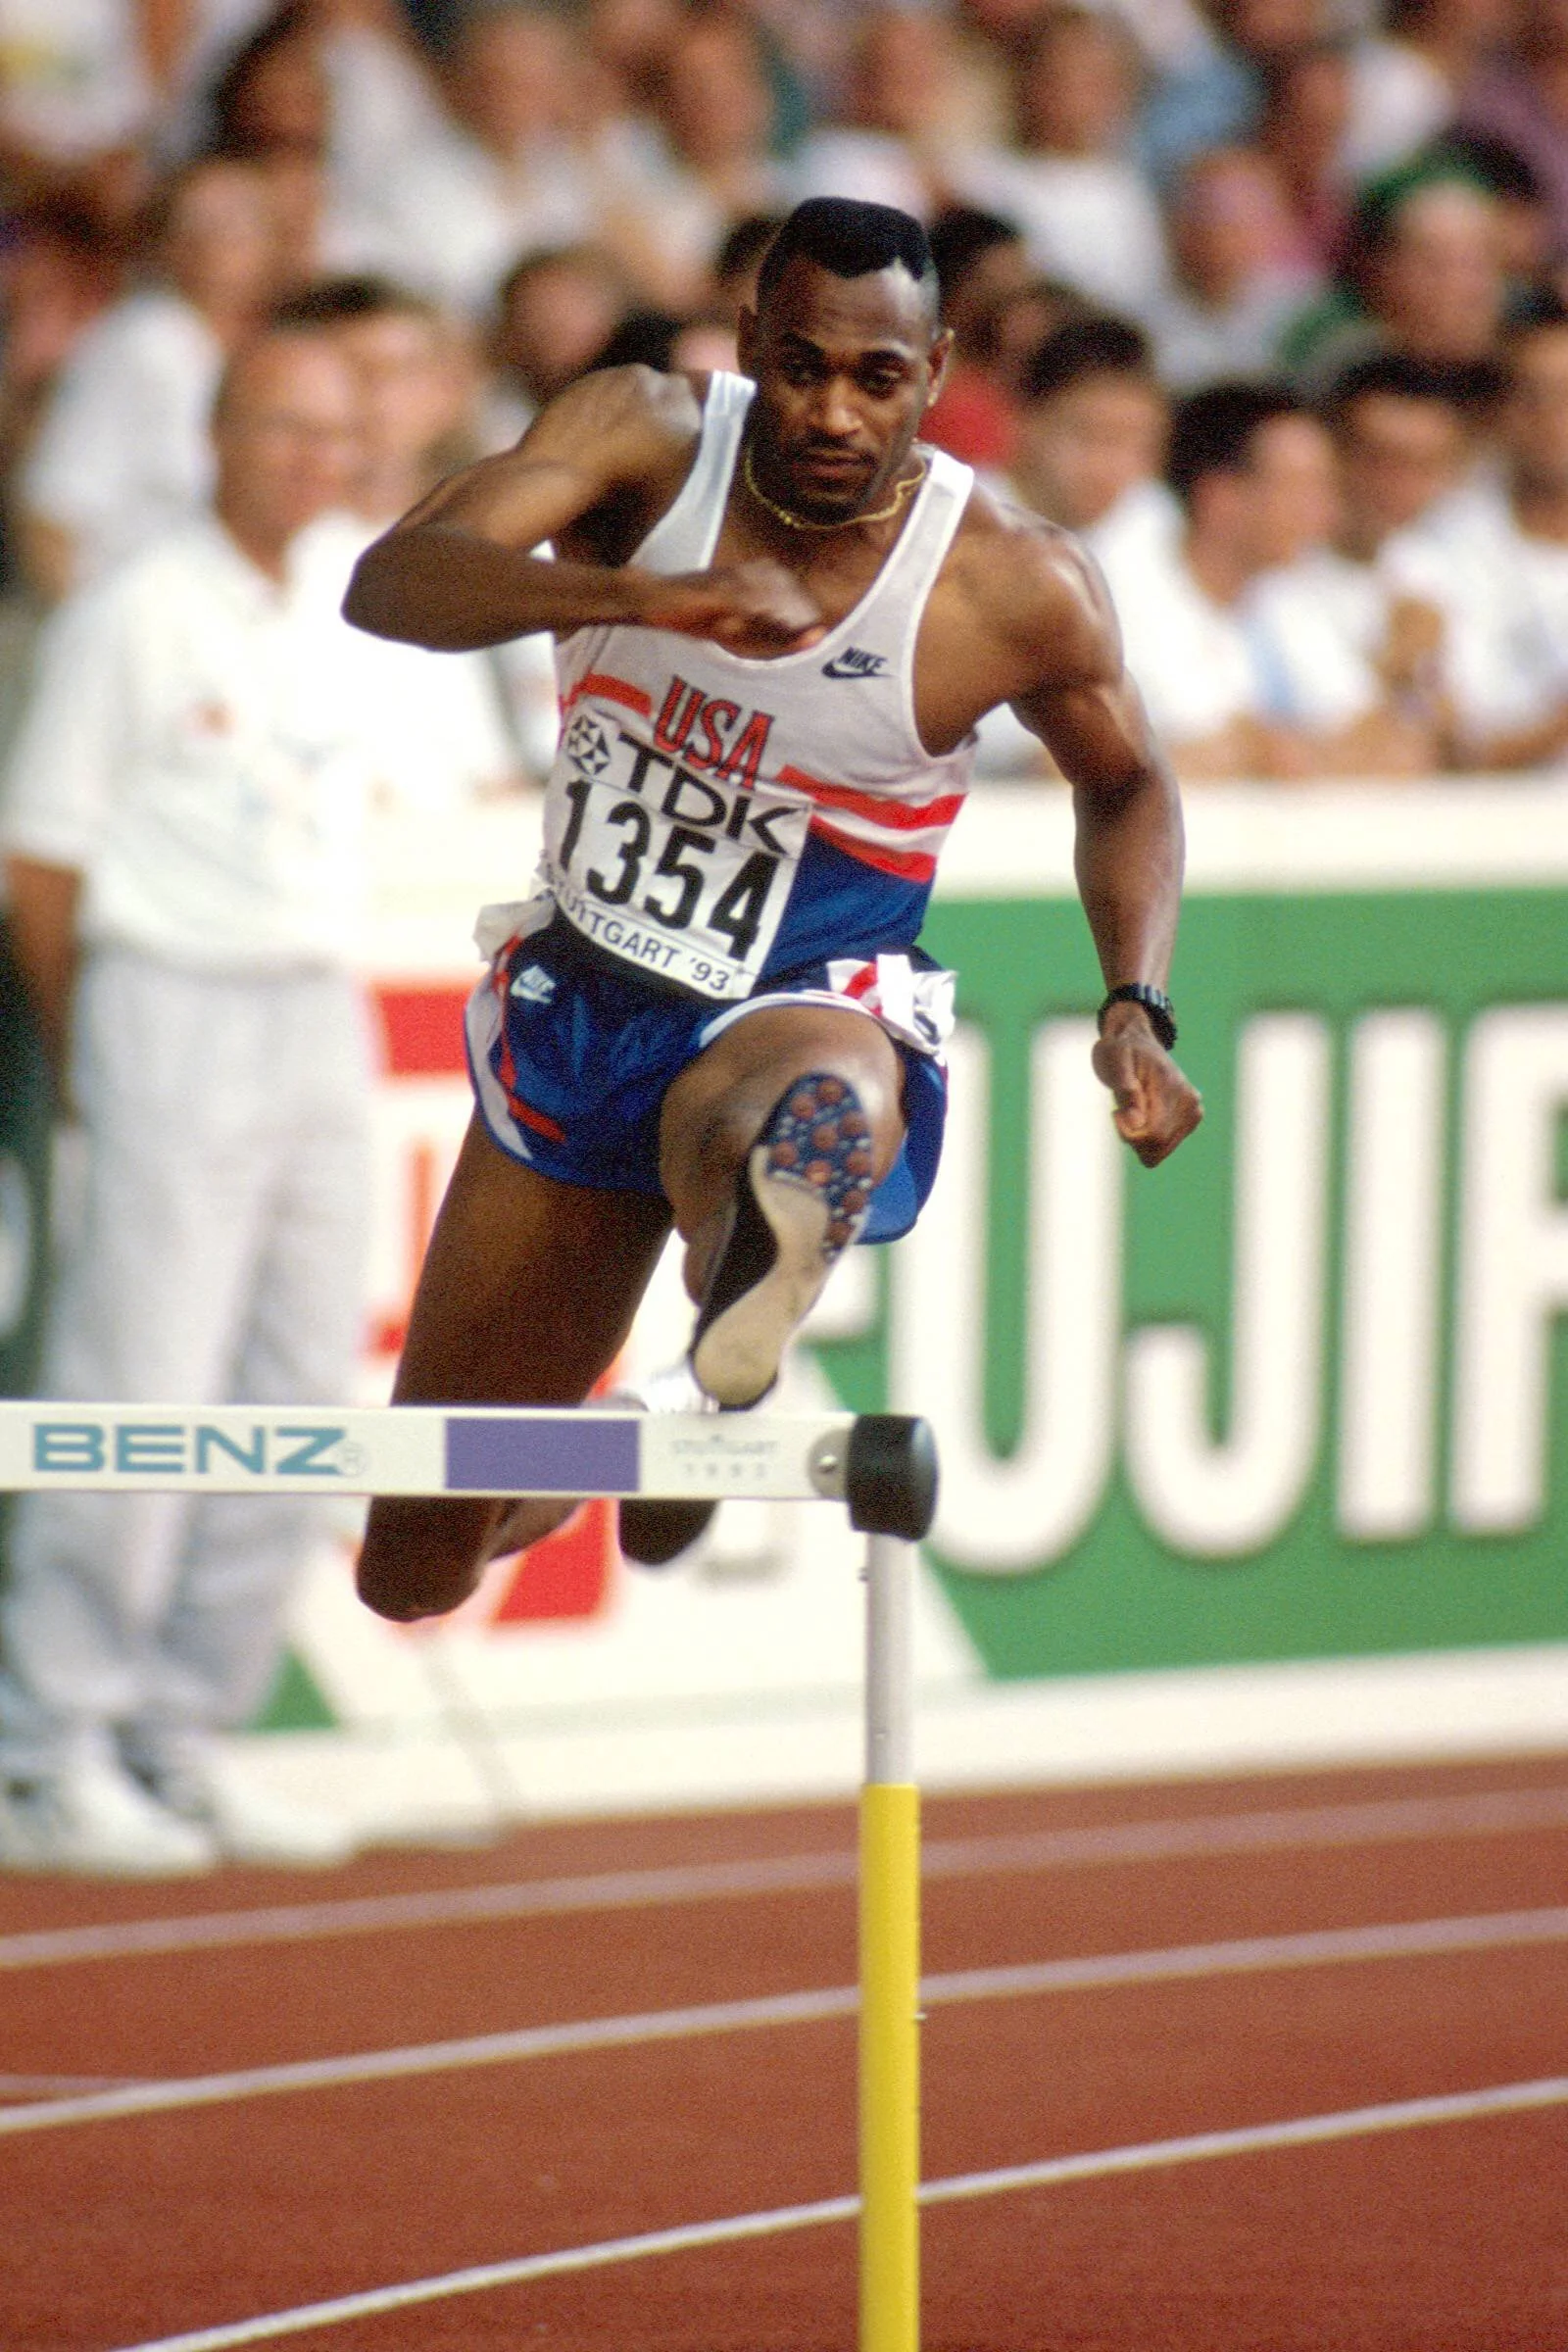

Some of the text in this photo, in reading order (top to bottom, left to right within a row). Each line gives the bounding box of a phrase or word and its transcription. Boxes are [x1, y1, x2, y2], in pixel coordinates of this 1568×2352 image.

[839, 646, 889, 670] NIKE
[654, 674, 774, 791] USA
[617, 731, 802, 856] TDK
[558, 779, 780, 962] 1354
[689, 956, 731, 992] '93
[799, 998, 1568, 1576] UJIF
[32, 1423, 346, 1475] BENZ
